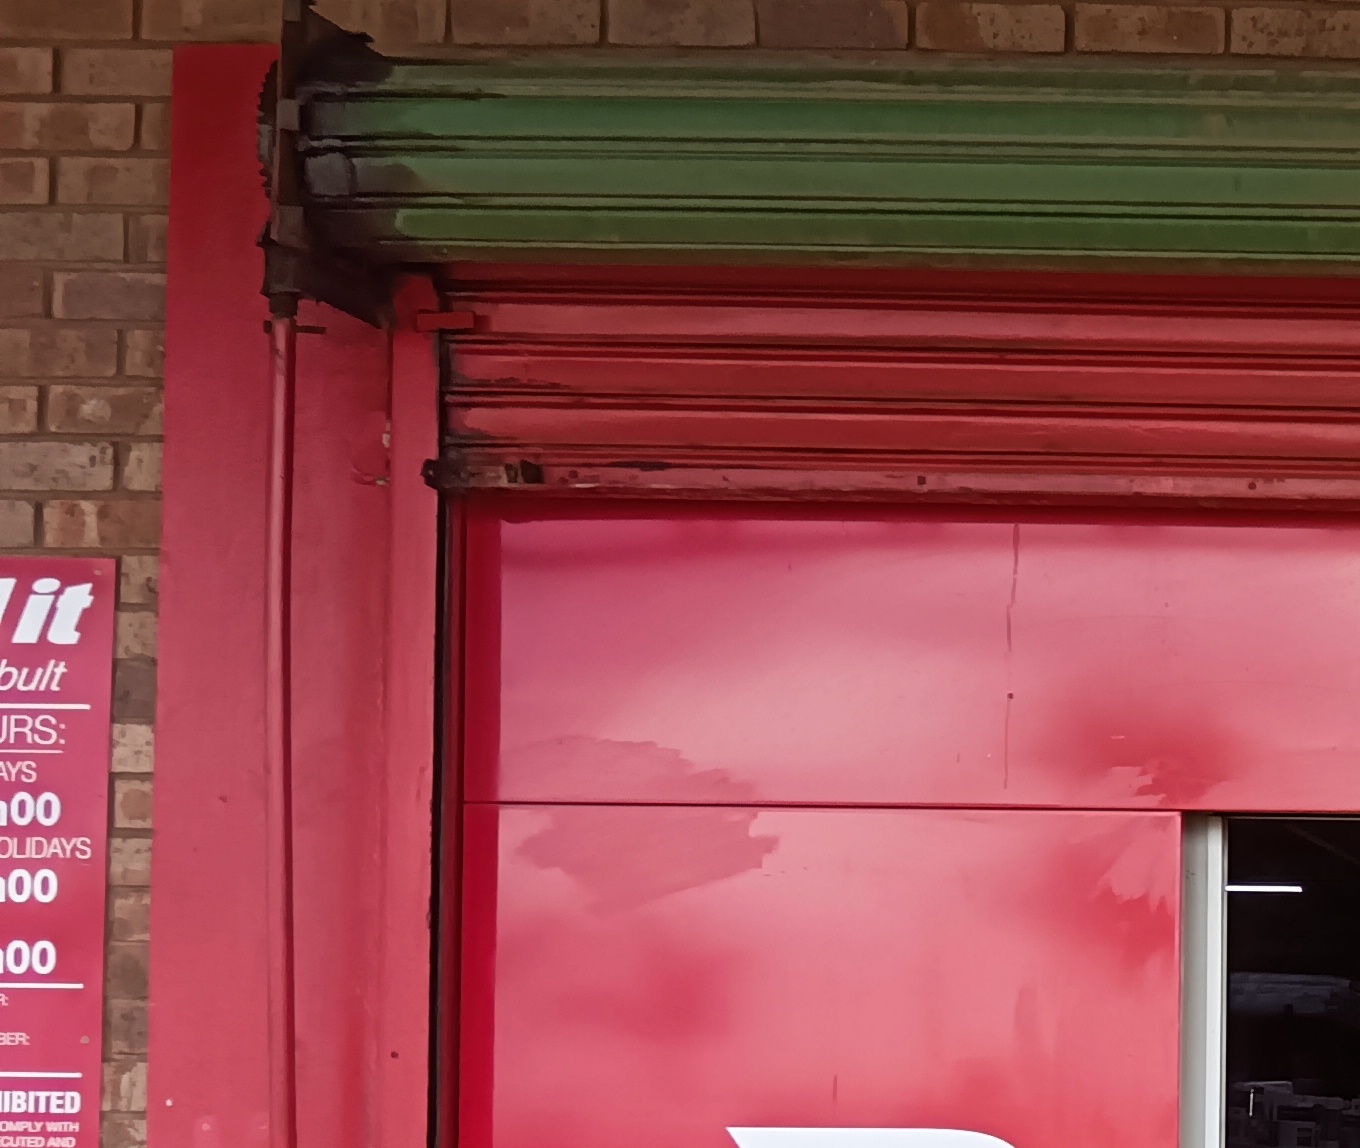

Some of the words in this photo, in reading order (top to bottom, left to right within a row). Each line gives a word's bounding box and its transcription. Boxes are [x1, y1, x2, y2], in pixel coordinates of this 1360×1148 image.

[11, 577, 95, 645] it
[0, 868, 58, 903] 00
[0, 940, 57, 974] 00
